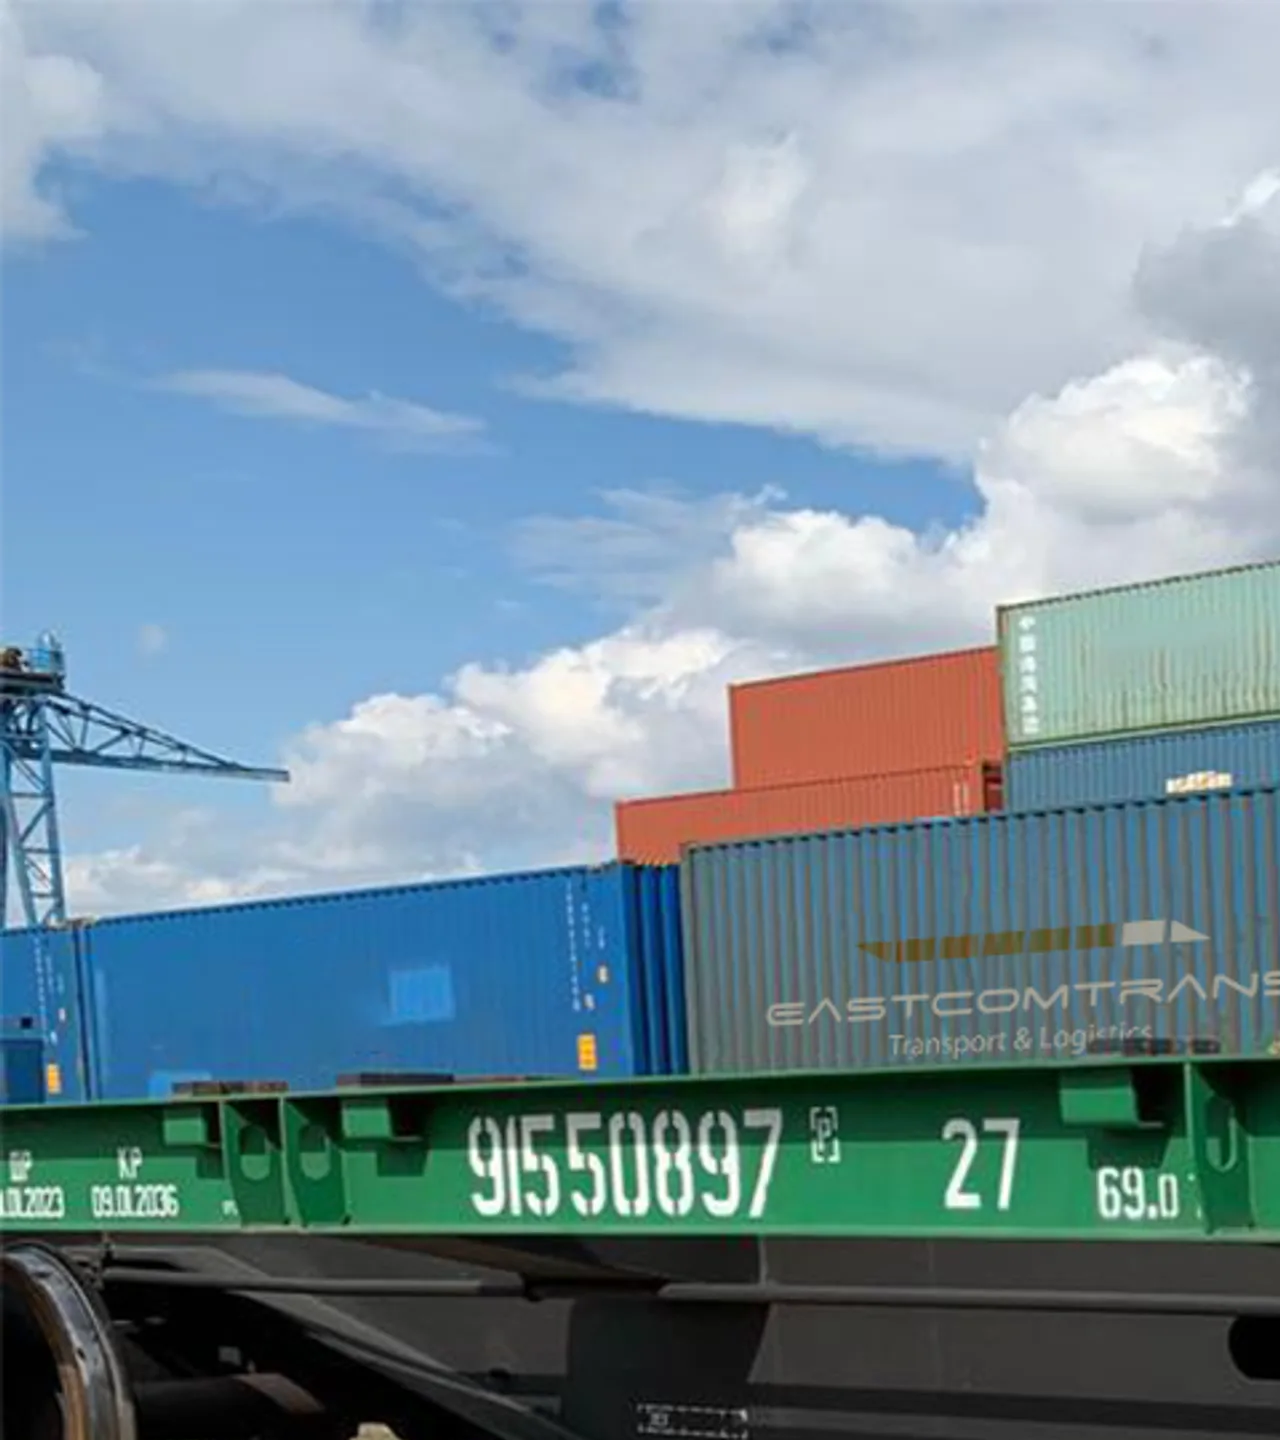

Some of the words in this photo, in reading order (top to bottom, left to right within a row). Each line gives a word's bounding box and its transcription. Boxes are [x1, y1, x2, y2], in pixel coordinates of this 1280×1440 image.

[889, 1029, 1005, 1062] Transport
[1012, 1026, 1034, 1053] &
[467, 1108, 783, 1218] 91550897
[941, 1117, 1020, 1211] 27
[1097, 1166, 1179, 1220] 69.0
